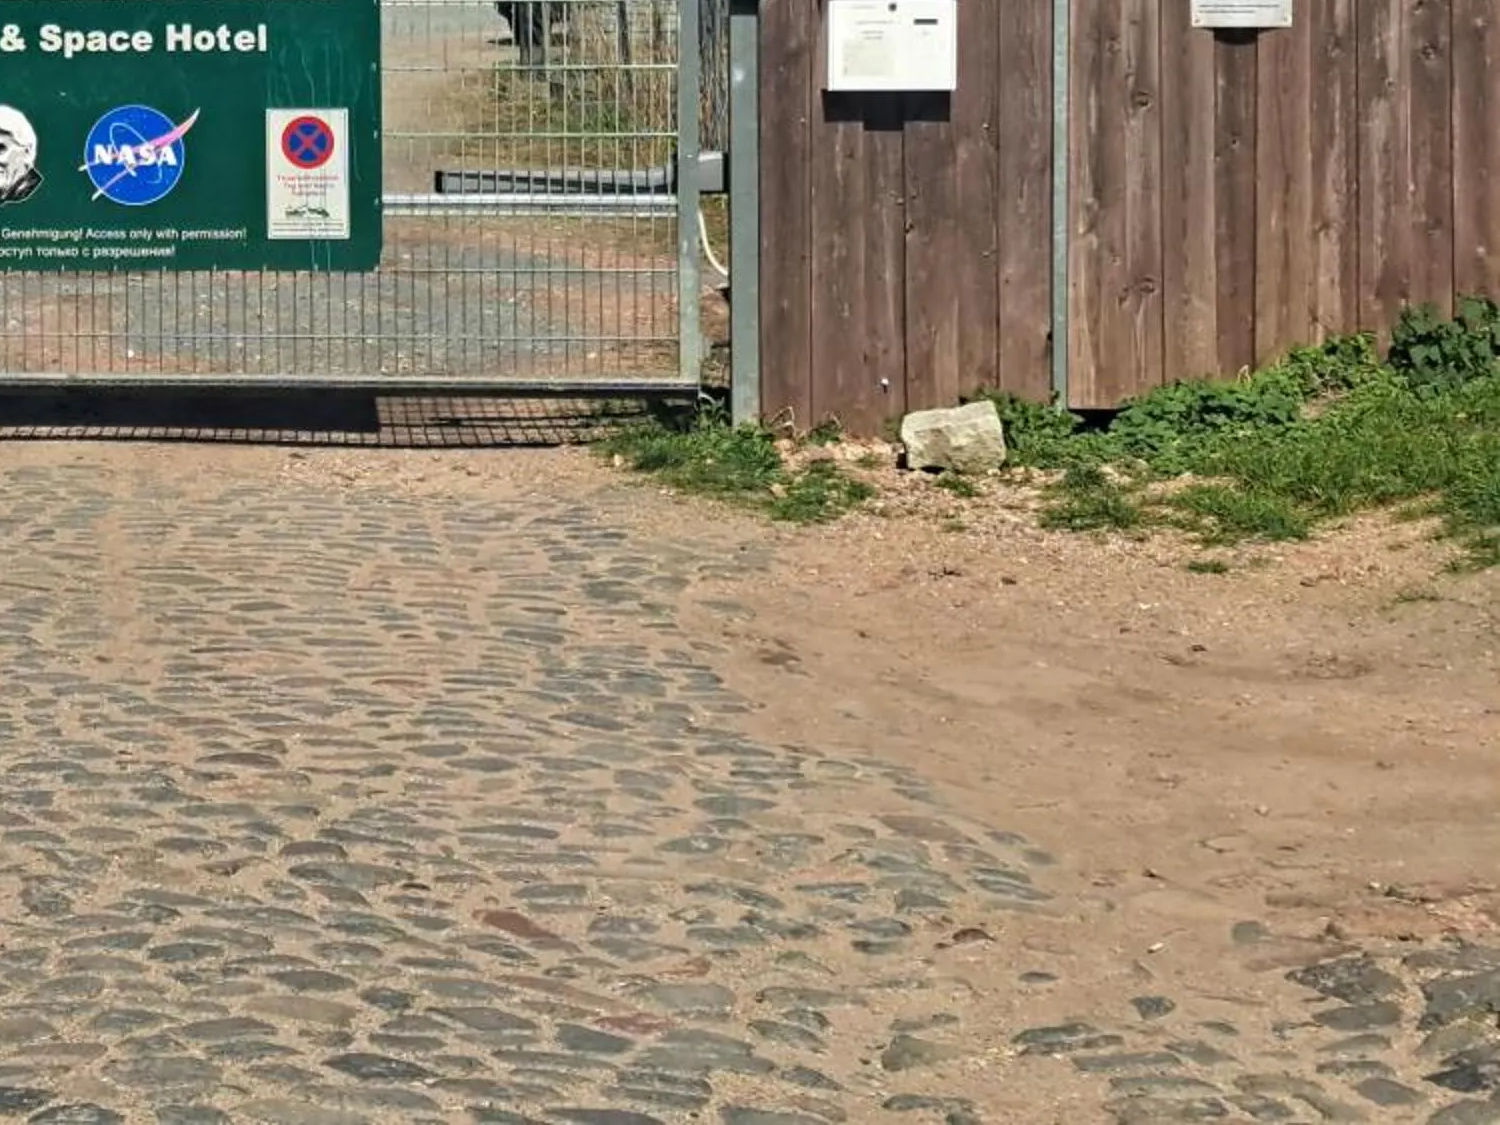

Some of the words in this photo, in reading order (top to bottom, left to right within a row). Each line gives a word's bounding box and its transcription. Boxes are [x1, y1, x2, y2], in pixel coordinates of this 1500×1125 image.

[39, 24, 154, 59] Space
[165, 23, 268, 52] Hotel
[94, 143, 178, 166] NASA
[1, 227, 83, 242] Genehmigung!
[86, 227, 127, 240] Access
[129, 227, 153, 242] only
[155, 227, 179, 240] with
[181, 227, 248, 242] permission!
[36, 246, 79, 257] только
